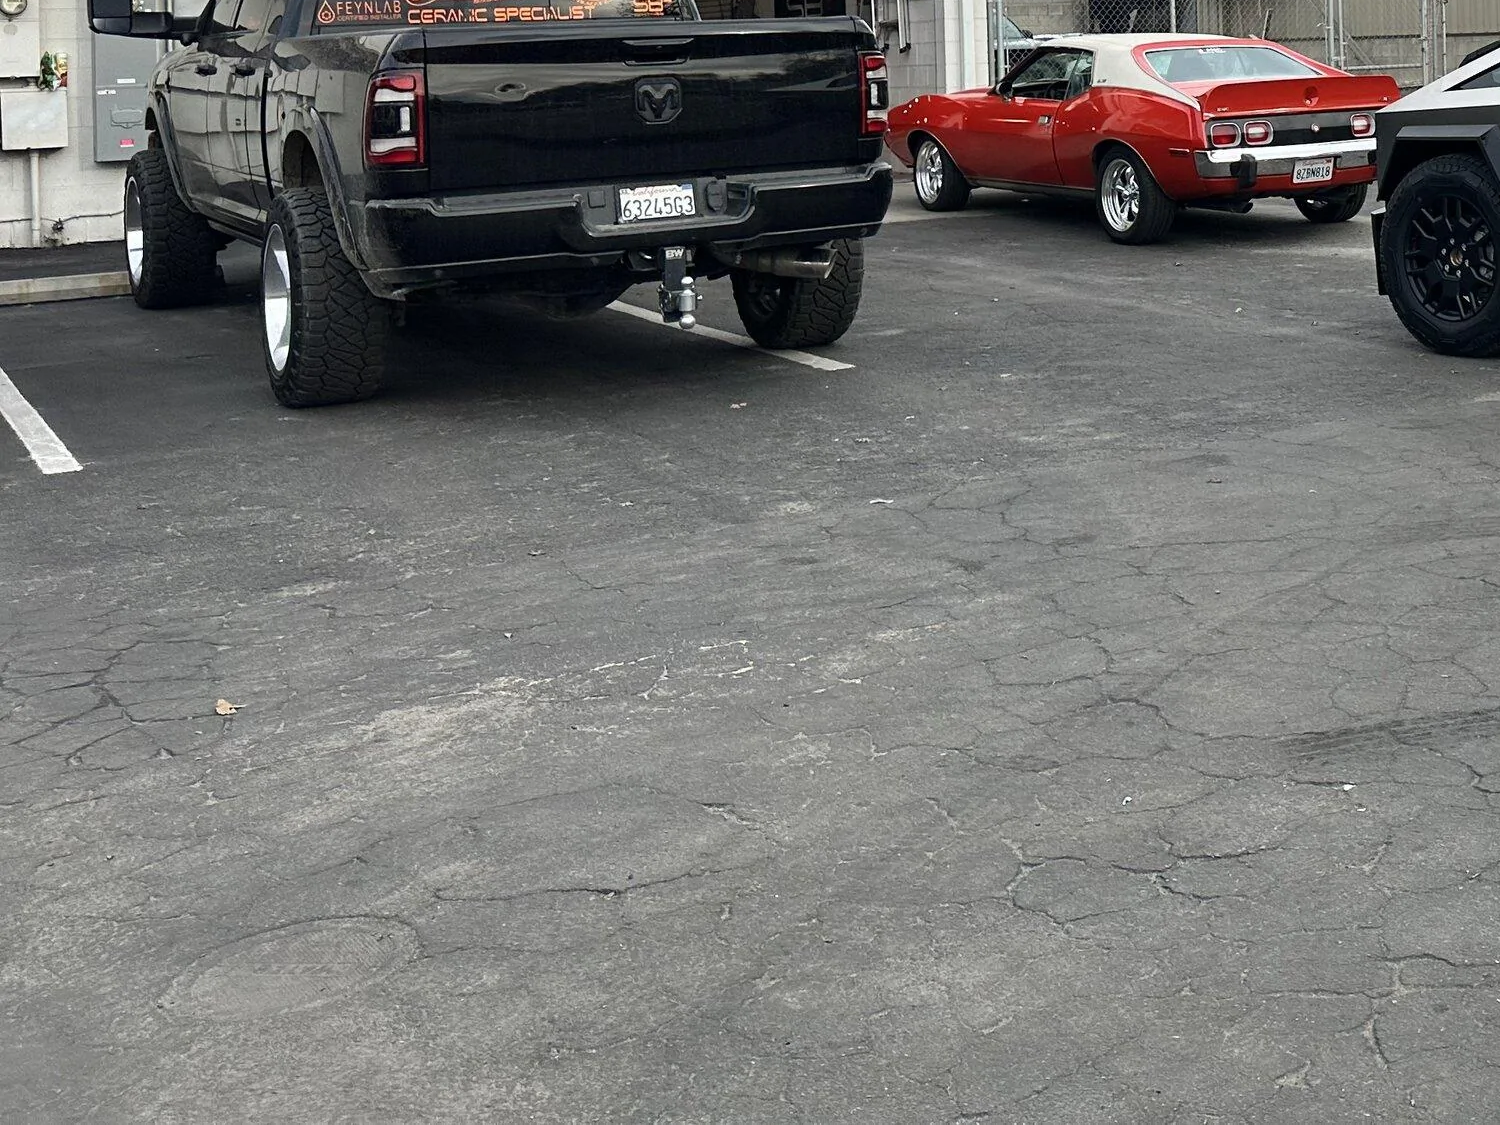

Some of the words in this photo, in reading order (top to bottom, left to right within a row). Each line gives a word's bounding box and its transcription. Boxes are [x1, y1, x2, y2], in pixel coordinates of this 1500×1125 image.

[336, 0, 402, 15] FEYNLAB
[407, 8, 488, 24] CERAMIC
[494, 5, 596, 22] SPECIALIST
[623, 196, 694, 218] 63245G3
